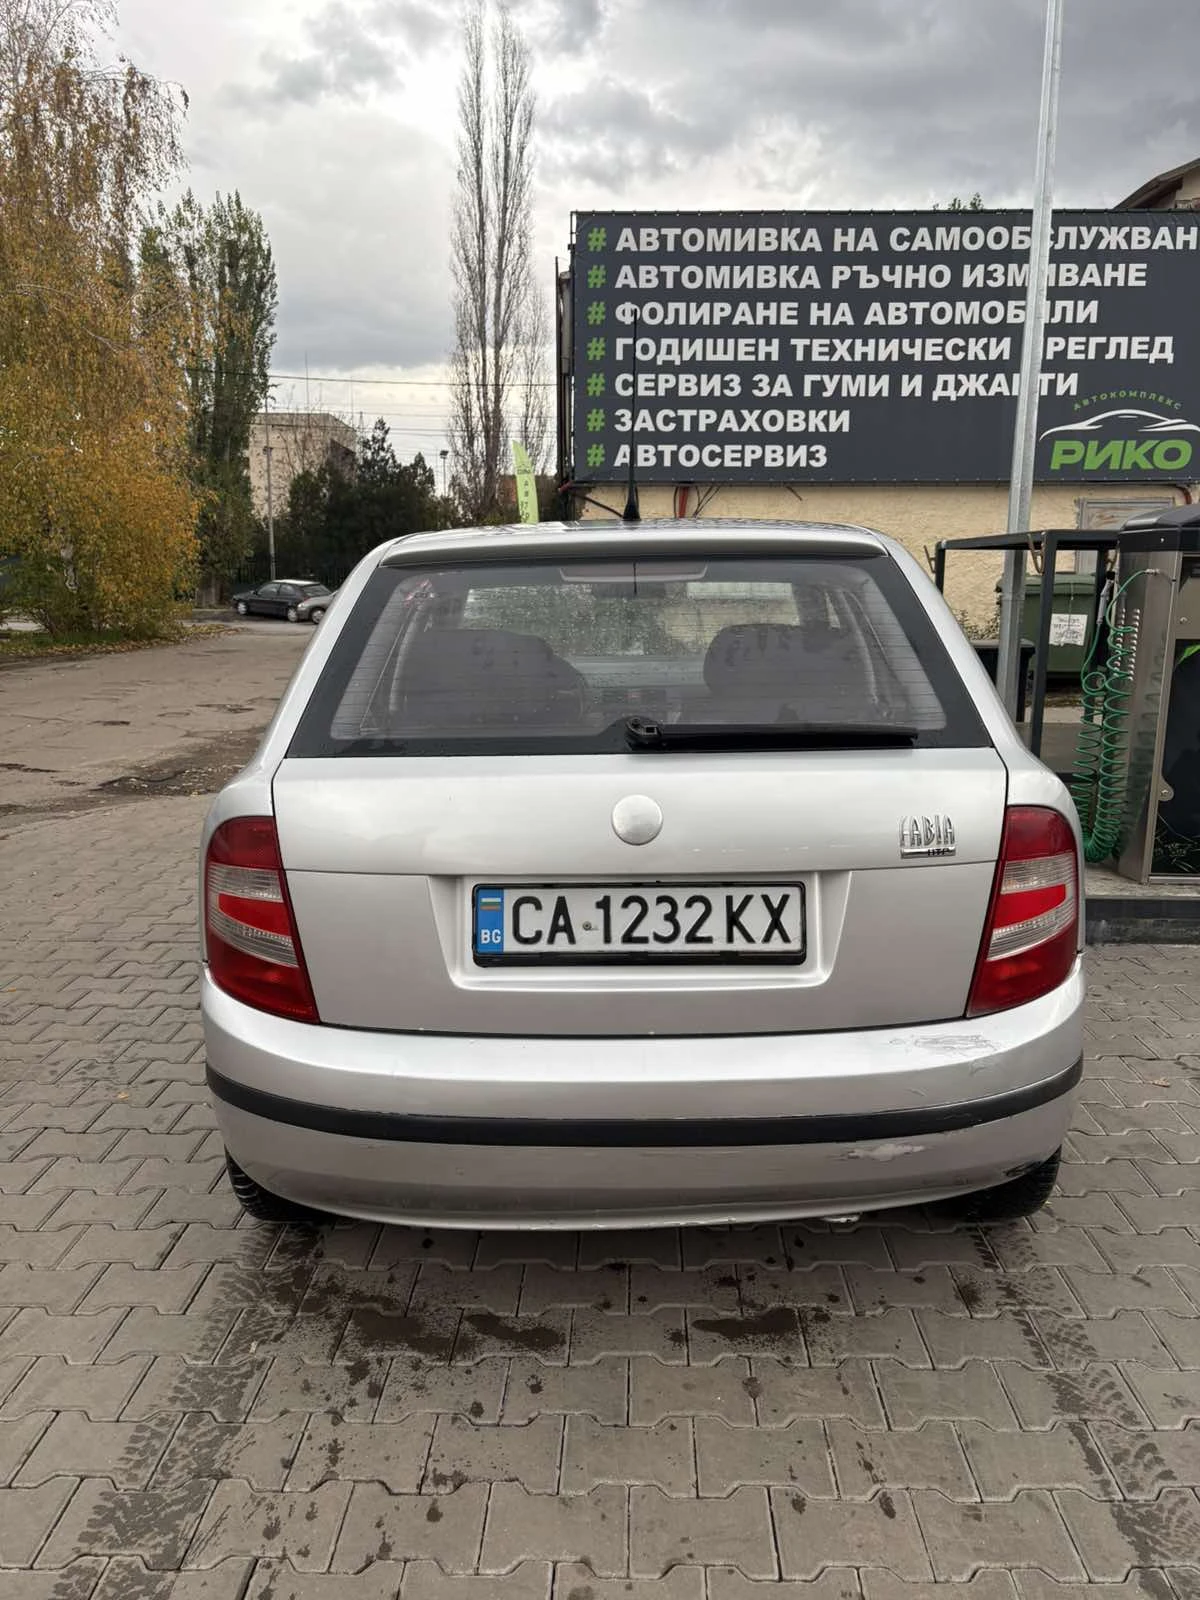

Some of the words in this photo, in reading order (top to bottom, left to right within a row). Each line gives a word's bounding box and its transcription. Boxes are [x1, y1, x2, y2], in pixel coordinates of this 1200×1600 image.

[615, 228, 822, 252] АВТОМИВКА
[833, 227, 878, 251] НА
[615, 265, 821, 289] АВТОМИВКА
[831, 264, 952, 289] РЪЧНО
[615, 302, 799, 326] ФОЛИРАНЕ
[809, 302, 854, 326] НА
[615, 338, 780, 366] ГОДИШЕН
[790, 337, 1011, 362] ТЕХНИЧЕСКИ
[1045, 336, 1174, 364] РЕГЛЕД
[614, 374, 742, 397] СЕРВИЗ
[752, 373, 793, 397] ЗА
[803, 374, 890, 398] ГУМИ
[901, 374, 923, 397] И
[614, 409, 850, 433] ЗАСТРАХОВКИ
[613, 444, 828, 468] АВТОСЕРВИЗ
[1050, 439, 1193, 471] РИКО
[899, 814, 956, 847] FABIA
[480, 929, 501, 945] BG
